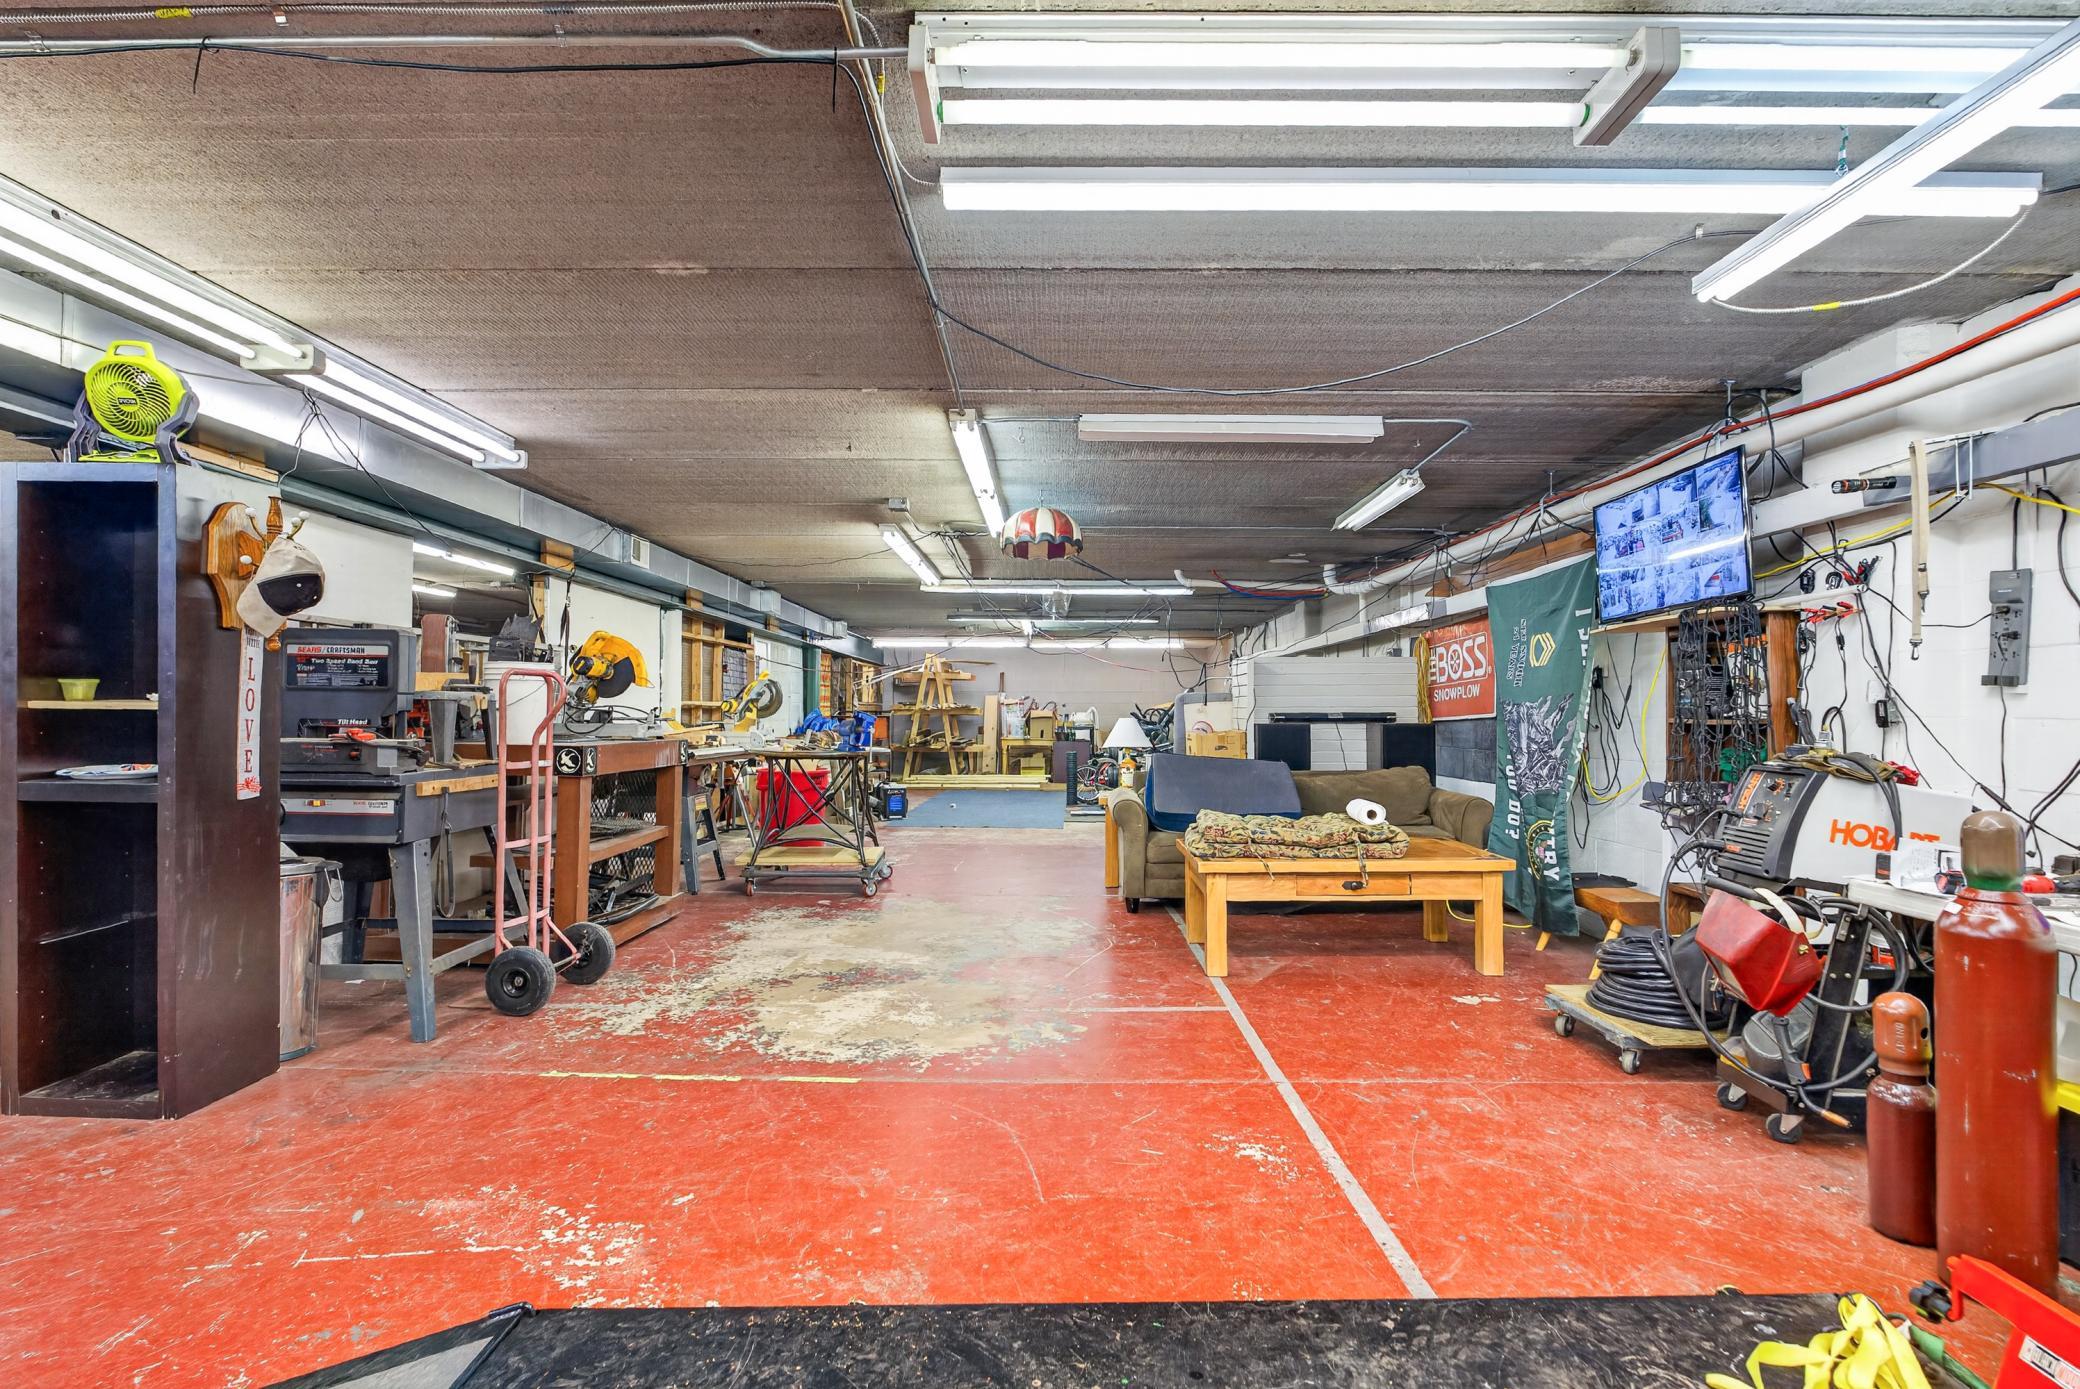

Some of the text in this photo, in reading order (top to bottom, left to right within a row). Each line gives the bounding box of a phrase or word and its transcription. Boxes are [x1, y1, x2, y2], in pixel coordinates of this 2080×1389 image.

[297, 646, 321, 654] SEARS
[326, 646, 366, 654] CRAFTSMAN
[326, 658, 346, 667] Speed
[1436, 635, 1487, 683] BOSS
[1506, 642, 1520, 680] YEARS
[1433, 684, 1480, 702] SNOWPLOW
[243, 657, 256, 773] LOVE
[337, 718, 369, 726] Tilt Head
[1505, 799, 1521, 840] DO?
